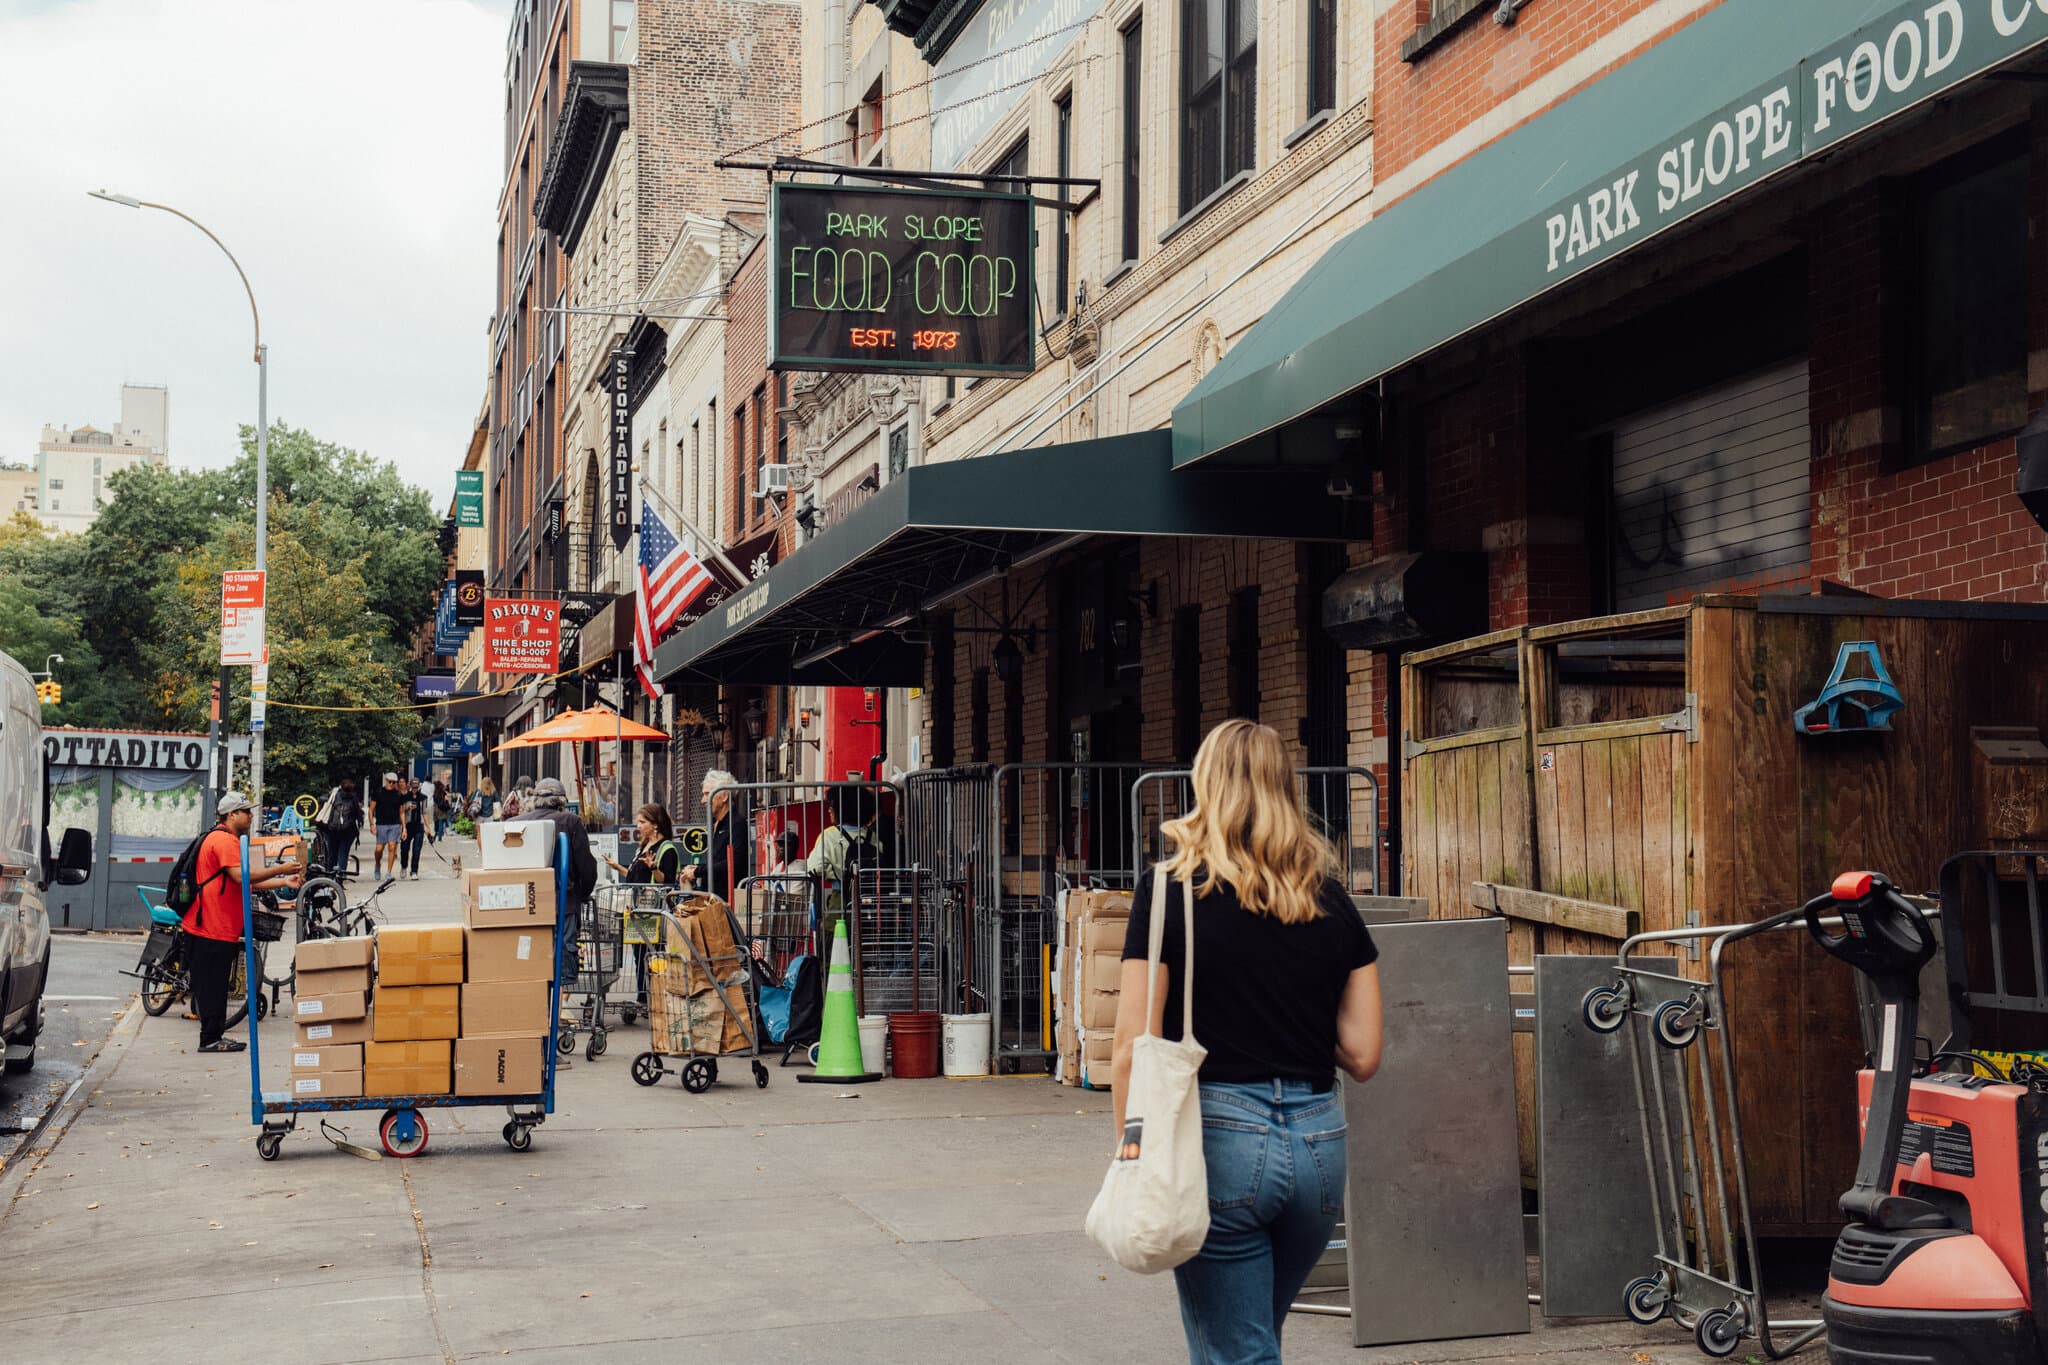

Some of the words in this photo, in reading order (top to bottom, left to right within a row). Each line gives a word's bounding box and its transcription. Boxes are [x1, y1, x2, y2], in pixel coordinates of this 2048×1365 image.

[956, 100, 986, 146] Years
[1546, 169, 1640, 273] PARK
[1657, 86, 1792, 214] SLOPE
[1813, 0, 1964, 134] FOOD
[826, 212, 889, 239] PARK
[903, 215, 984, 242] SLOPE
[790, 246, 892, 313] FOOD
[914, 251, 1017, 317] COOP
[912, 330, 959, 349] 1973
[616, 359, 628, 526] SCOTTADITO
[225, 574, 233, 582] NO
[234, 573, 260, 582] STANDING
[236, 584, 248, 592] Zone
[492, 603, 555, 622] DIXON'S
[492, 639, 518, 647] BIKE
[521, 640, 552, 648] SHOP
[690, 830, 704, 851] 3
[528, 881, 537, 916] PLACON
[497, 1049, 505, 1084] PLACON
